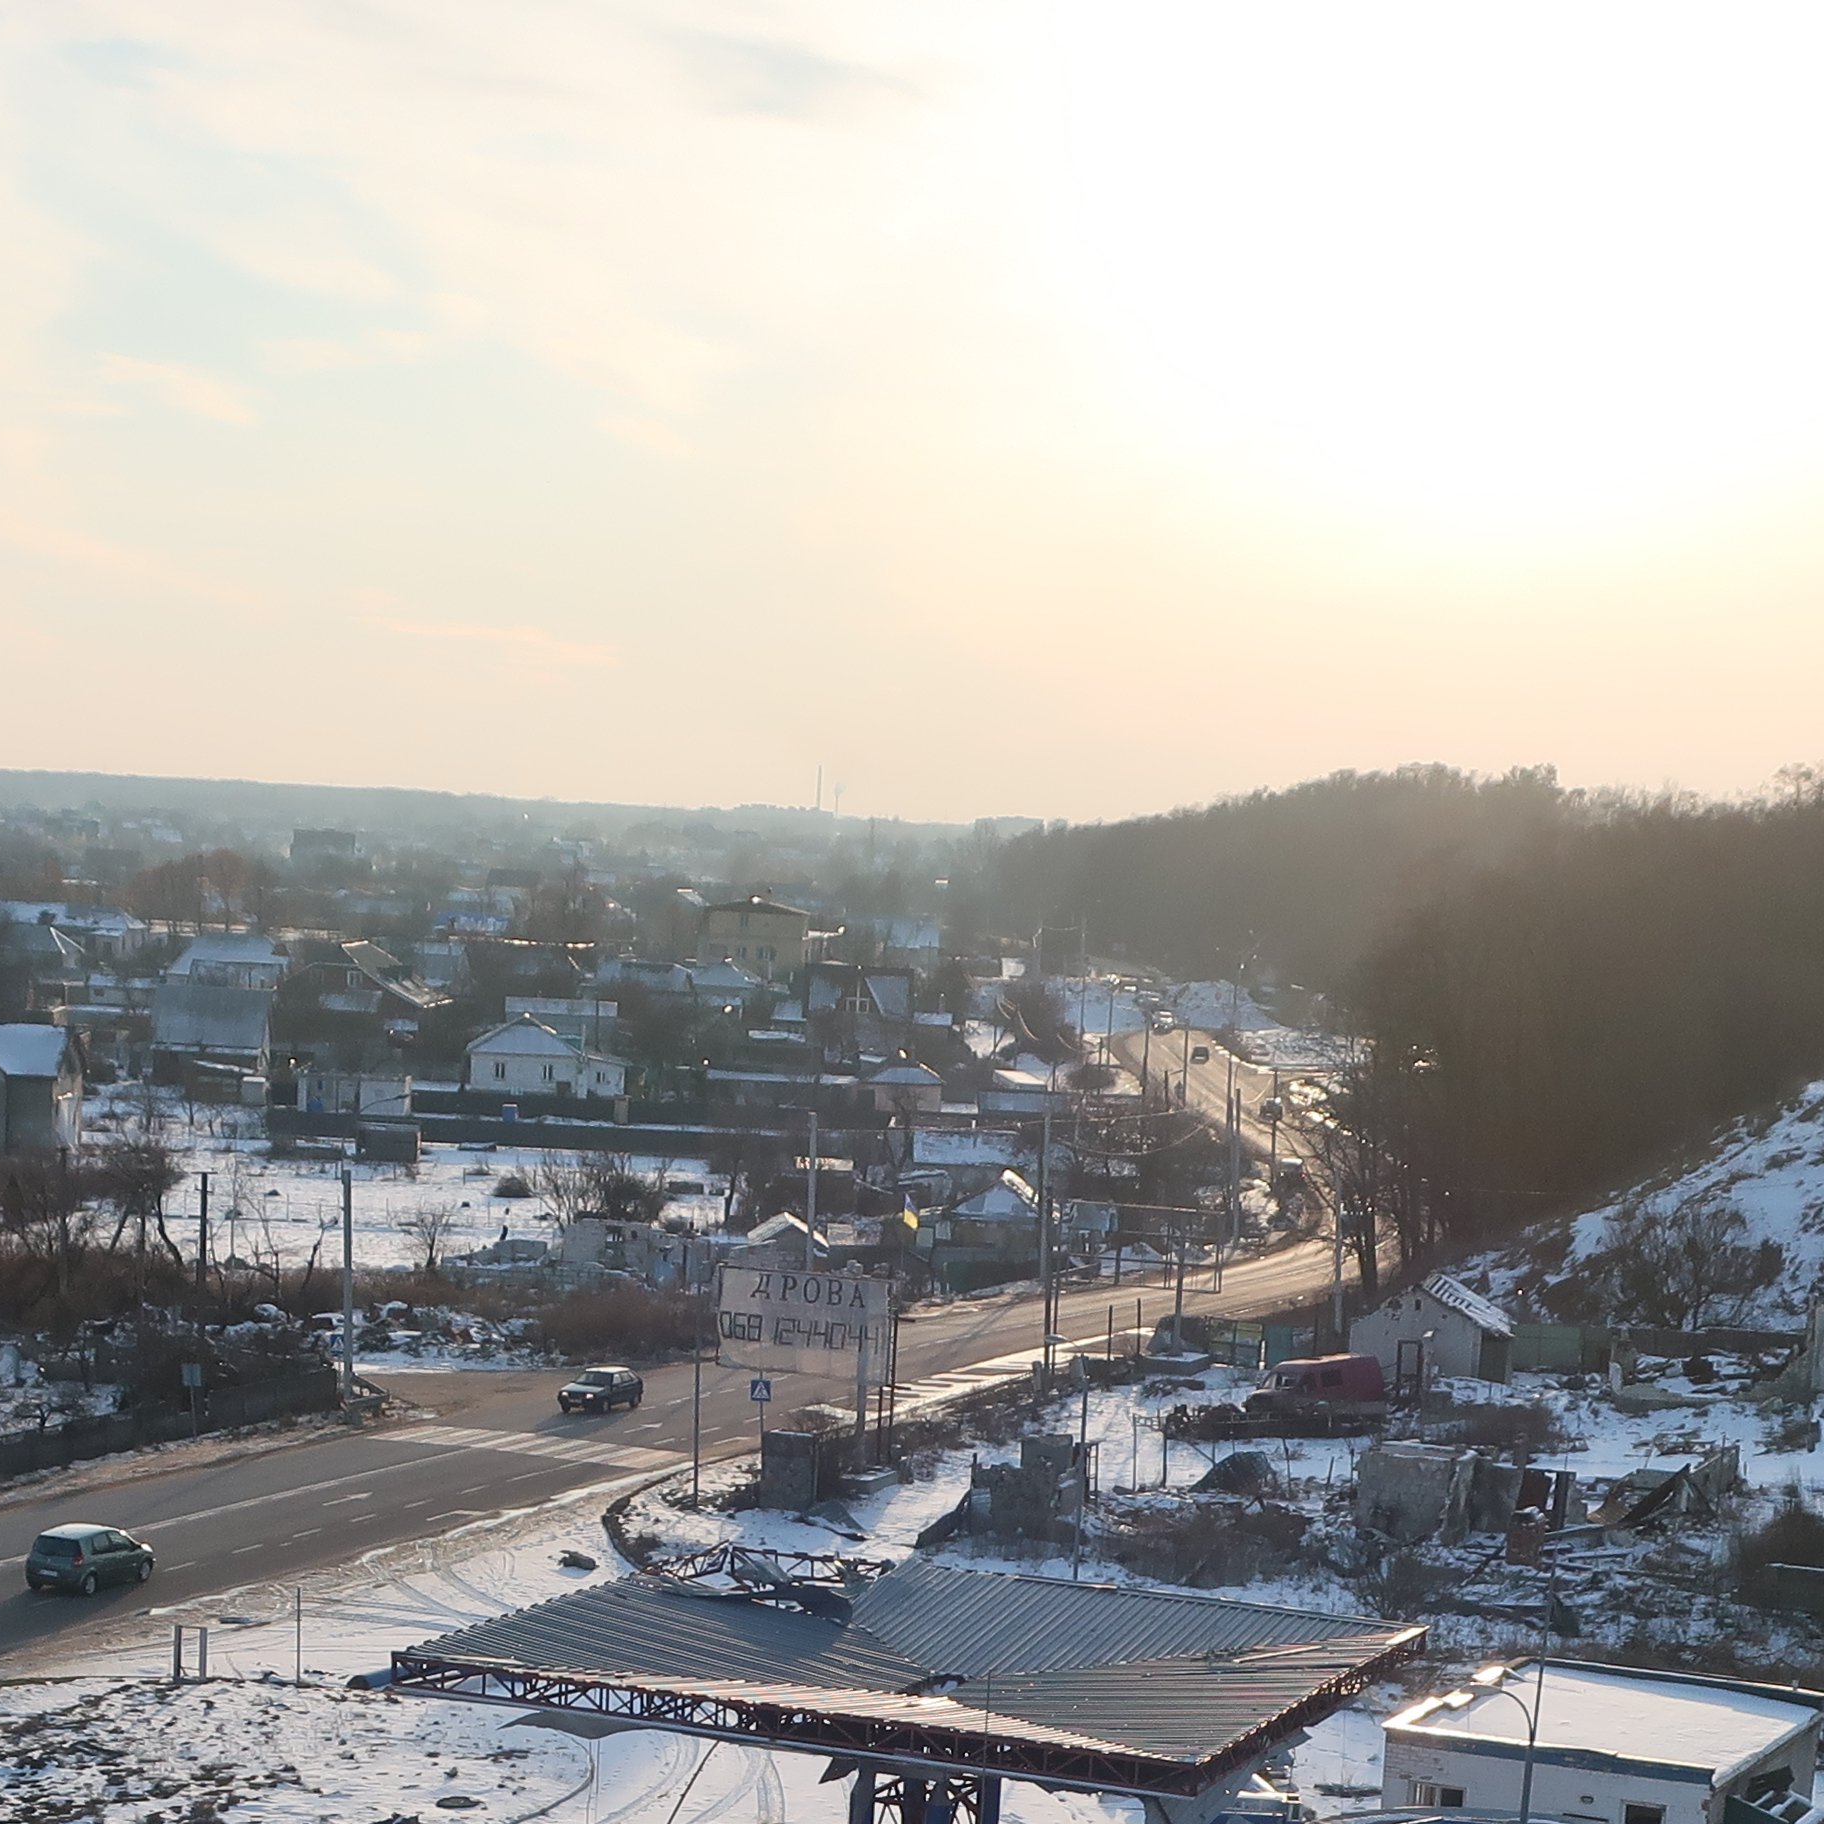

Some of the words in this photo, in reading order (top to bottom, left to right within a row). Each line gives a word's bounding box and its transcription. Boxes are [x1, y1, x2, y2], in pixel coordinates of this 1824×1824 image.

[750, 1273, 866, 1309] ДРОВА
[719, 1310, 763, 1342] 068
[774, 1316, 879, 1355] 1244044
